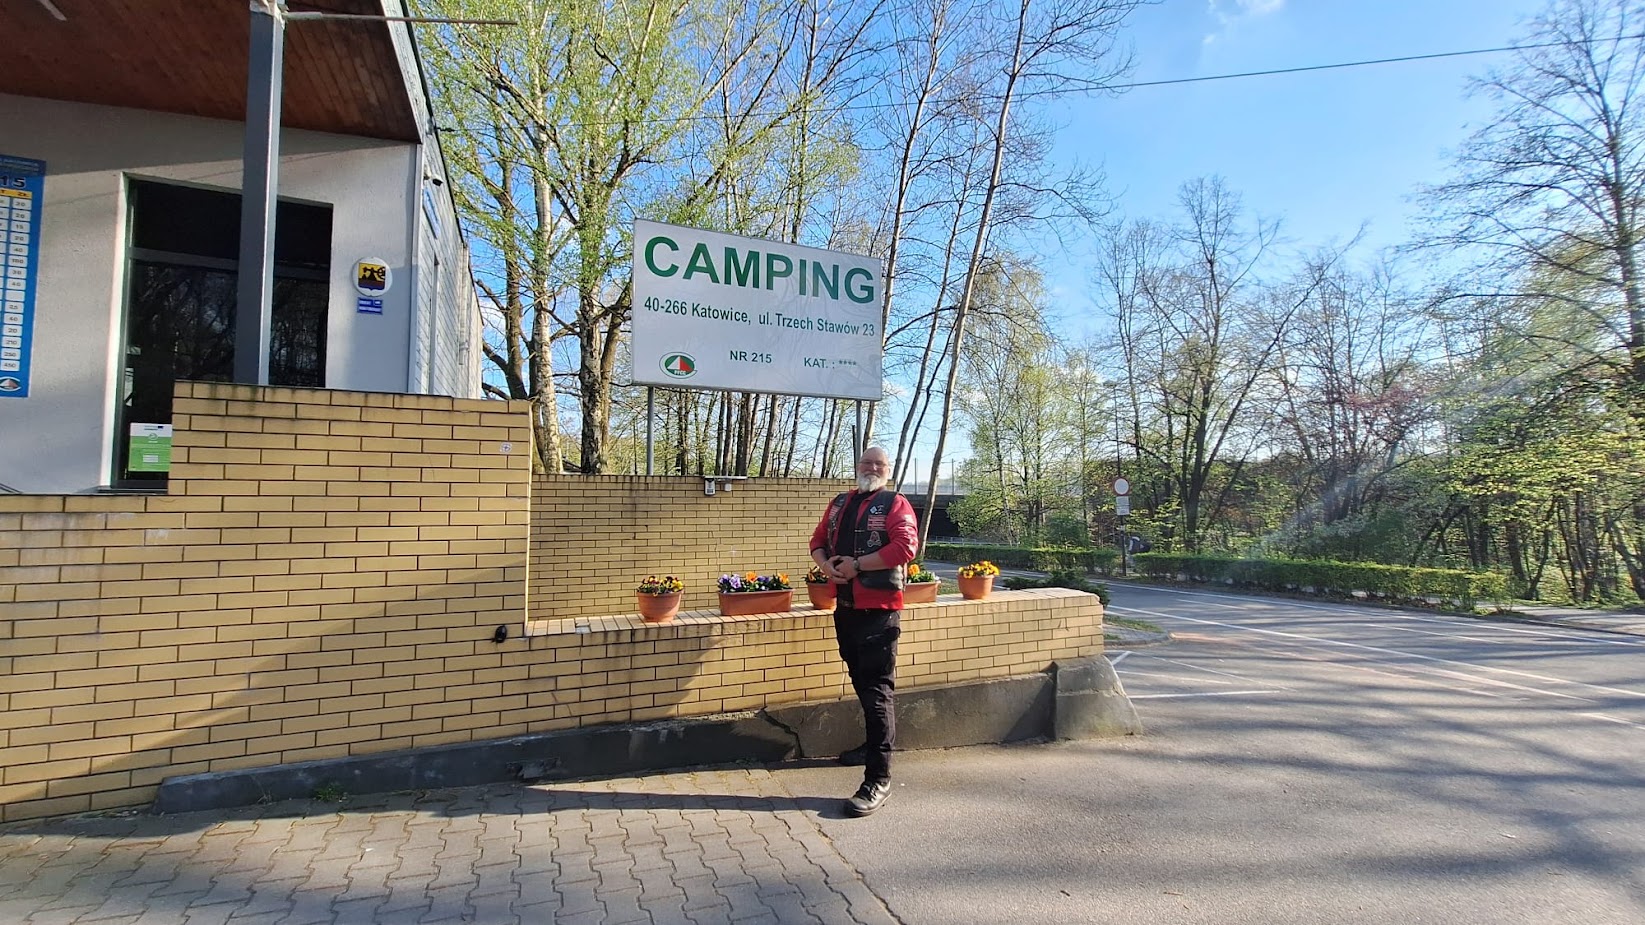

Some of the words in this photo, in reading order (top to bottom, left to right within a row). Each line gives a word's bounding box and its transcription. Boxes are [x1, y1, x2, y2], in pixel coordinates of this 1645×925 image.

[644, 236, 875, 304] CAMPING
[644, 296, 688, 316] 40-266
[691, 302, 751, 326] Katowice,
[758, 312, 773, 326] ul.
[775, 312, 813, 331] Trzech
[817, 318, 860, 335] Stawów
[862, 323, 876, 337] 23
[730, 350, 748, 362] NR
[751, 352, 772, 364] 215
